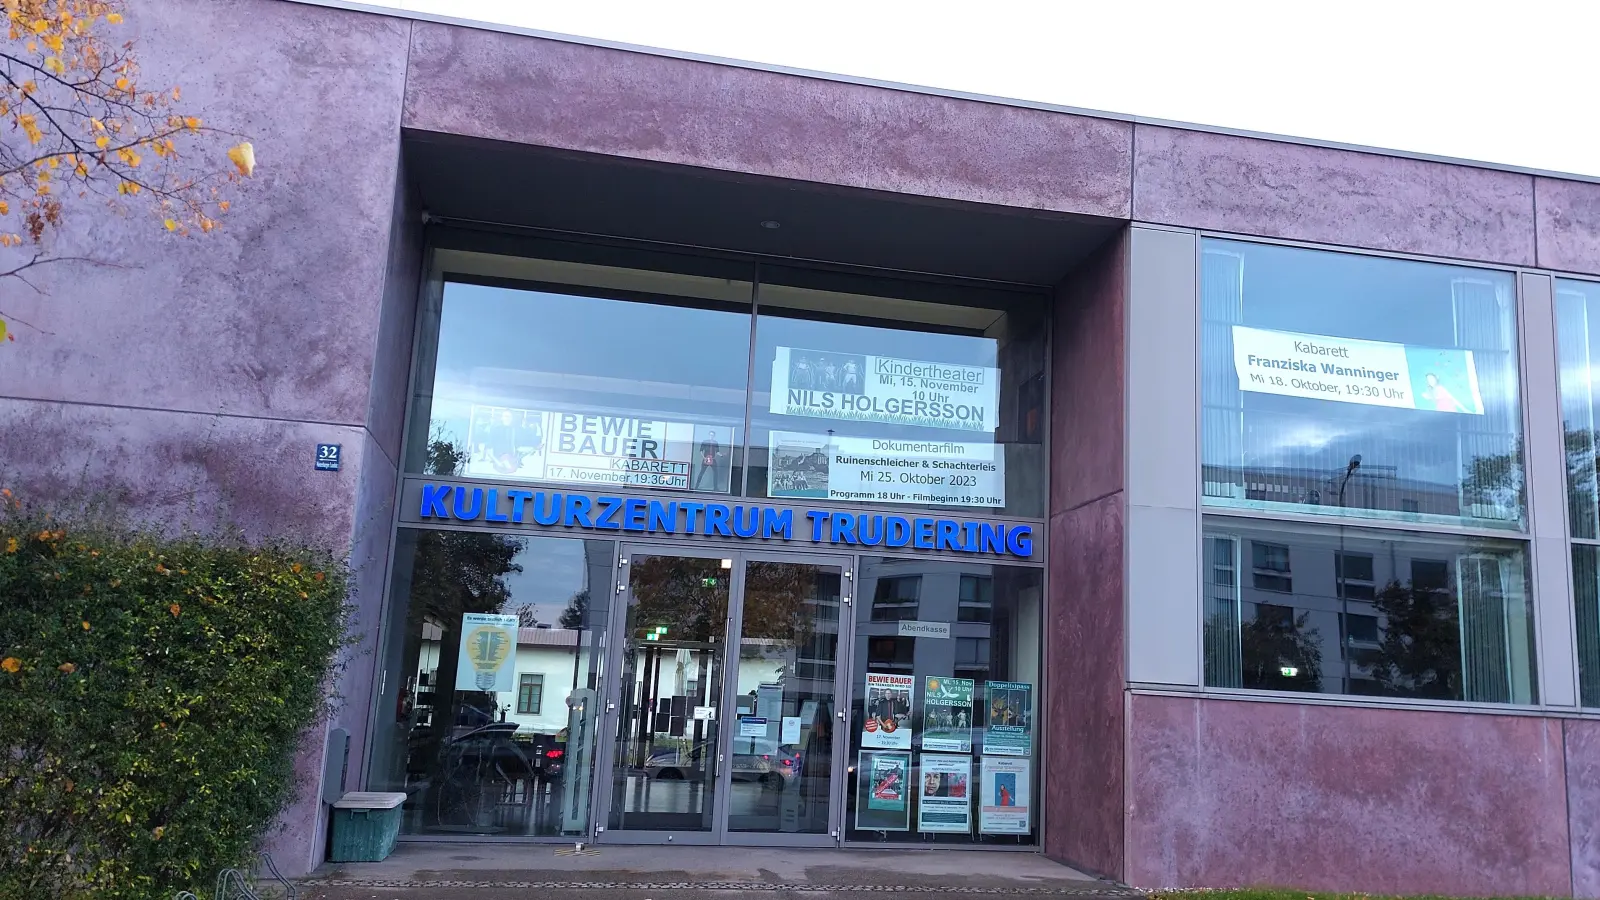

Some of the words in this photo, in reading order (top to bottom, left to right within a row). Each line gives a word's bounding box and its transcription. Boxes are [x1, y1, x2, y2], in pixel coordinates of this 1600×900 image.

[1294, 341, 1349, 358] Kabarett
[878, 358, 982, 382] Kindertheater
[1248, 354, 1317, 373] Franziska
[1320, 363, 1399, 382] Wanninger
[879, 374, 896, 387] Mi,
[901, 377, 916, 387] 15.
[920, 378, 978, 393] November
[1250, 373, 1265, 384] Mi
[1269, 376, 1287, 387] 18.
[1291, 378, 1341, 395] Oktober,
[1346, 384, 1380, 397] 19:30
[1383, 387, 1404, 400] Uhr
[788, 389, 834, 408] NILS
[842, 394, 984, 421] HOLGERSSON
[912, 391, 925, 400] 10
[929, 392, 949, 403] Uhr
[560, 413, 653, 439] BEWIE
[319, 445, 337, 458] 32
[558, 433, 658, 459] BAUER
[872, 439, 965, 454] Dokumentarfilm
[611, 458, 687, 474] KABARETT
[836, 455, 919, 468] Ruinenschleicher
[922, 460, 930, 468] &
[932, 460, 996, 472] Schachterleis
[550, 467, 567, 478] 17.
[860, 471, 873, 482] Mi
[877, 472, 895, 483] 25.
[900, 472, 945, 485] Oktober
[949, 475, 977, 487] 2023
[830, 489, 875, 500] Programm
[877, 491, 888, 499] 18
[890, 492, 905, 500] Uhr
[913, 493, 959, 504] Filmbeginn
[961, 495, 985, 504] 19:30
[987, 496, 1002, 504] Uhr
[420, 484, 793, 540] KULTURZENTRUM
[807, 510, 1033, 557] TRUDERING
[901, 623, 948, 634] Abendkasse
[868, 676, 889, 684] BEWIE
[890, 677, 912, 685] BAUER
[926, 699, 972, 708] HOLGERSSON
[991, 725, 1024, 733] Ausstellung
